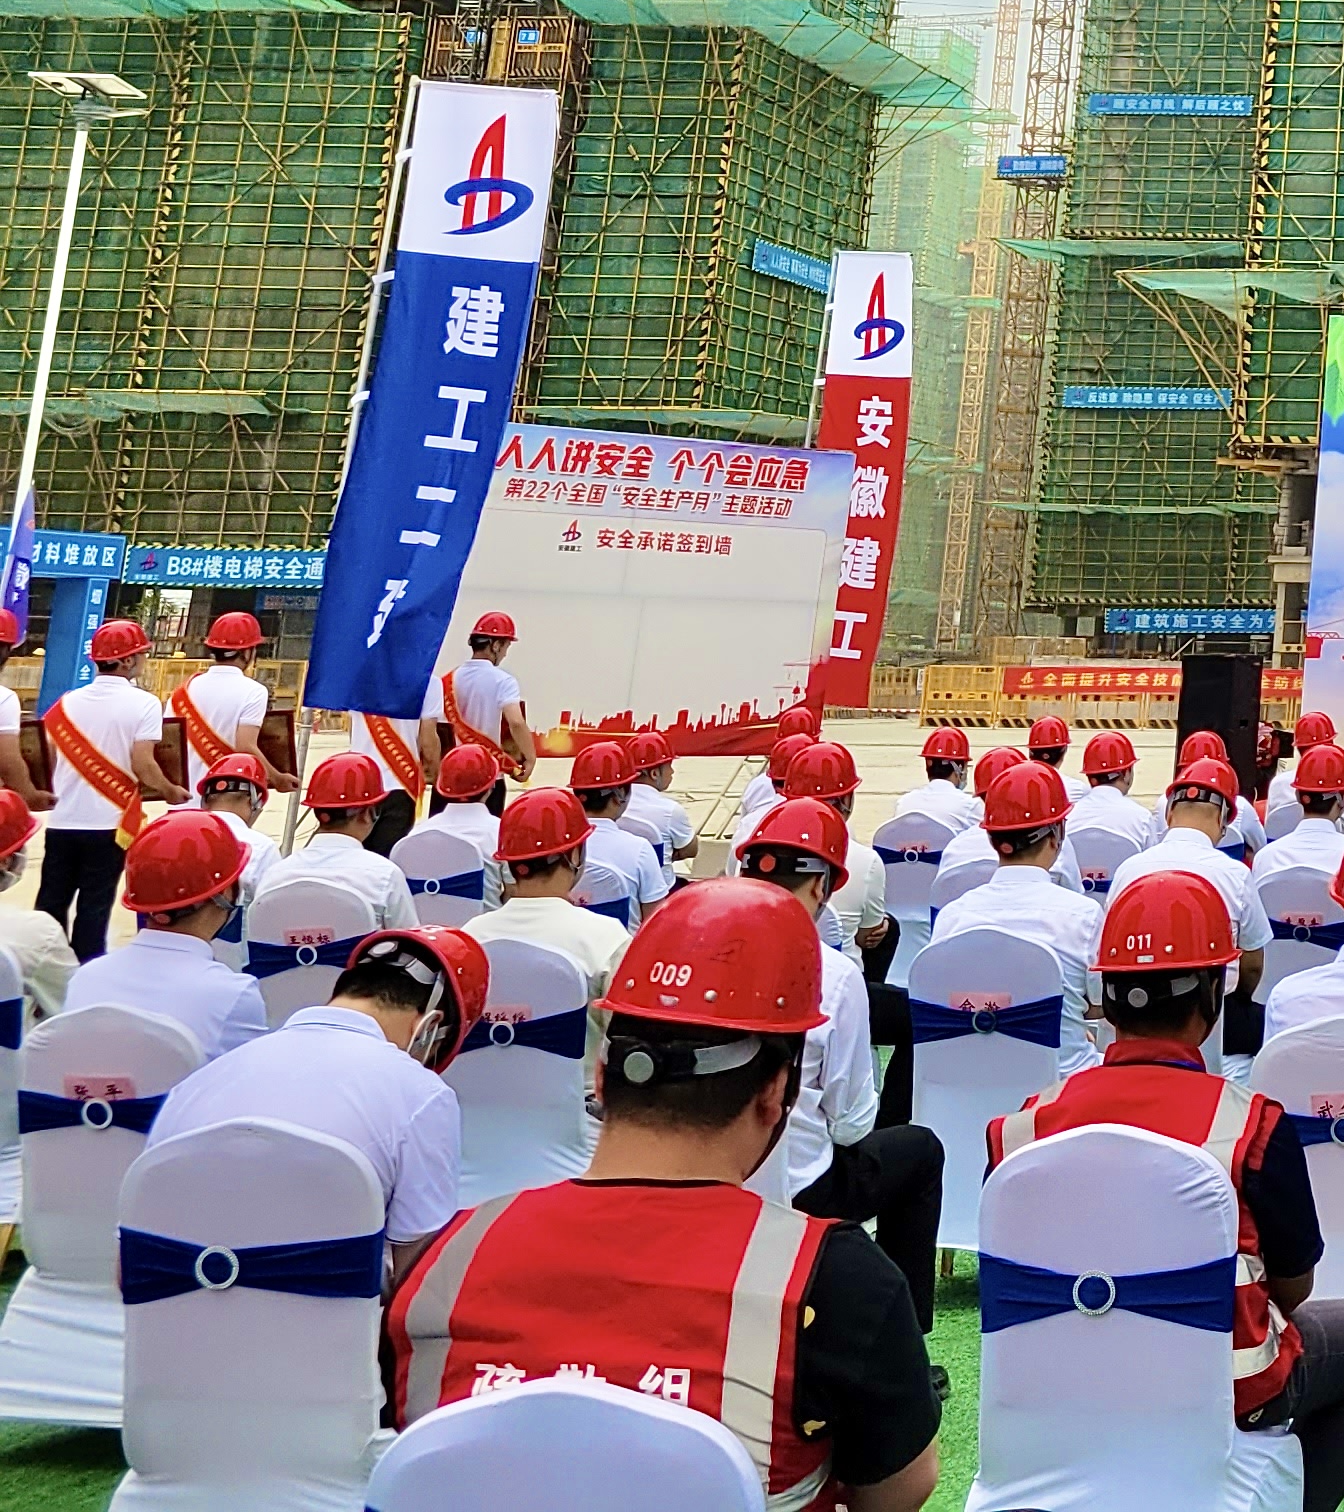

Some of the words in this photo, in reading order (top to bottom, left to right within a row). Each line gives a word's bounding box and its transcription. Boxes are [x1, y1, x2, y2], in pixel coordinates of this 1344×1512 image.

[497, 435, 655, 480] 人人讲安全
[669, 449, 811, 490] 个个会应急
[830, 395, 893, 660] 安徽建工
[597, 528, 732, 555] 安全承诺签到墙
[166, 554, 325, 580] B8#楼电梯安全通
[1126, 933, 1152, 951] 011
[650, 961, 692, 987] 009
